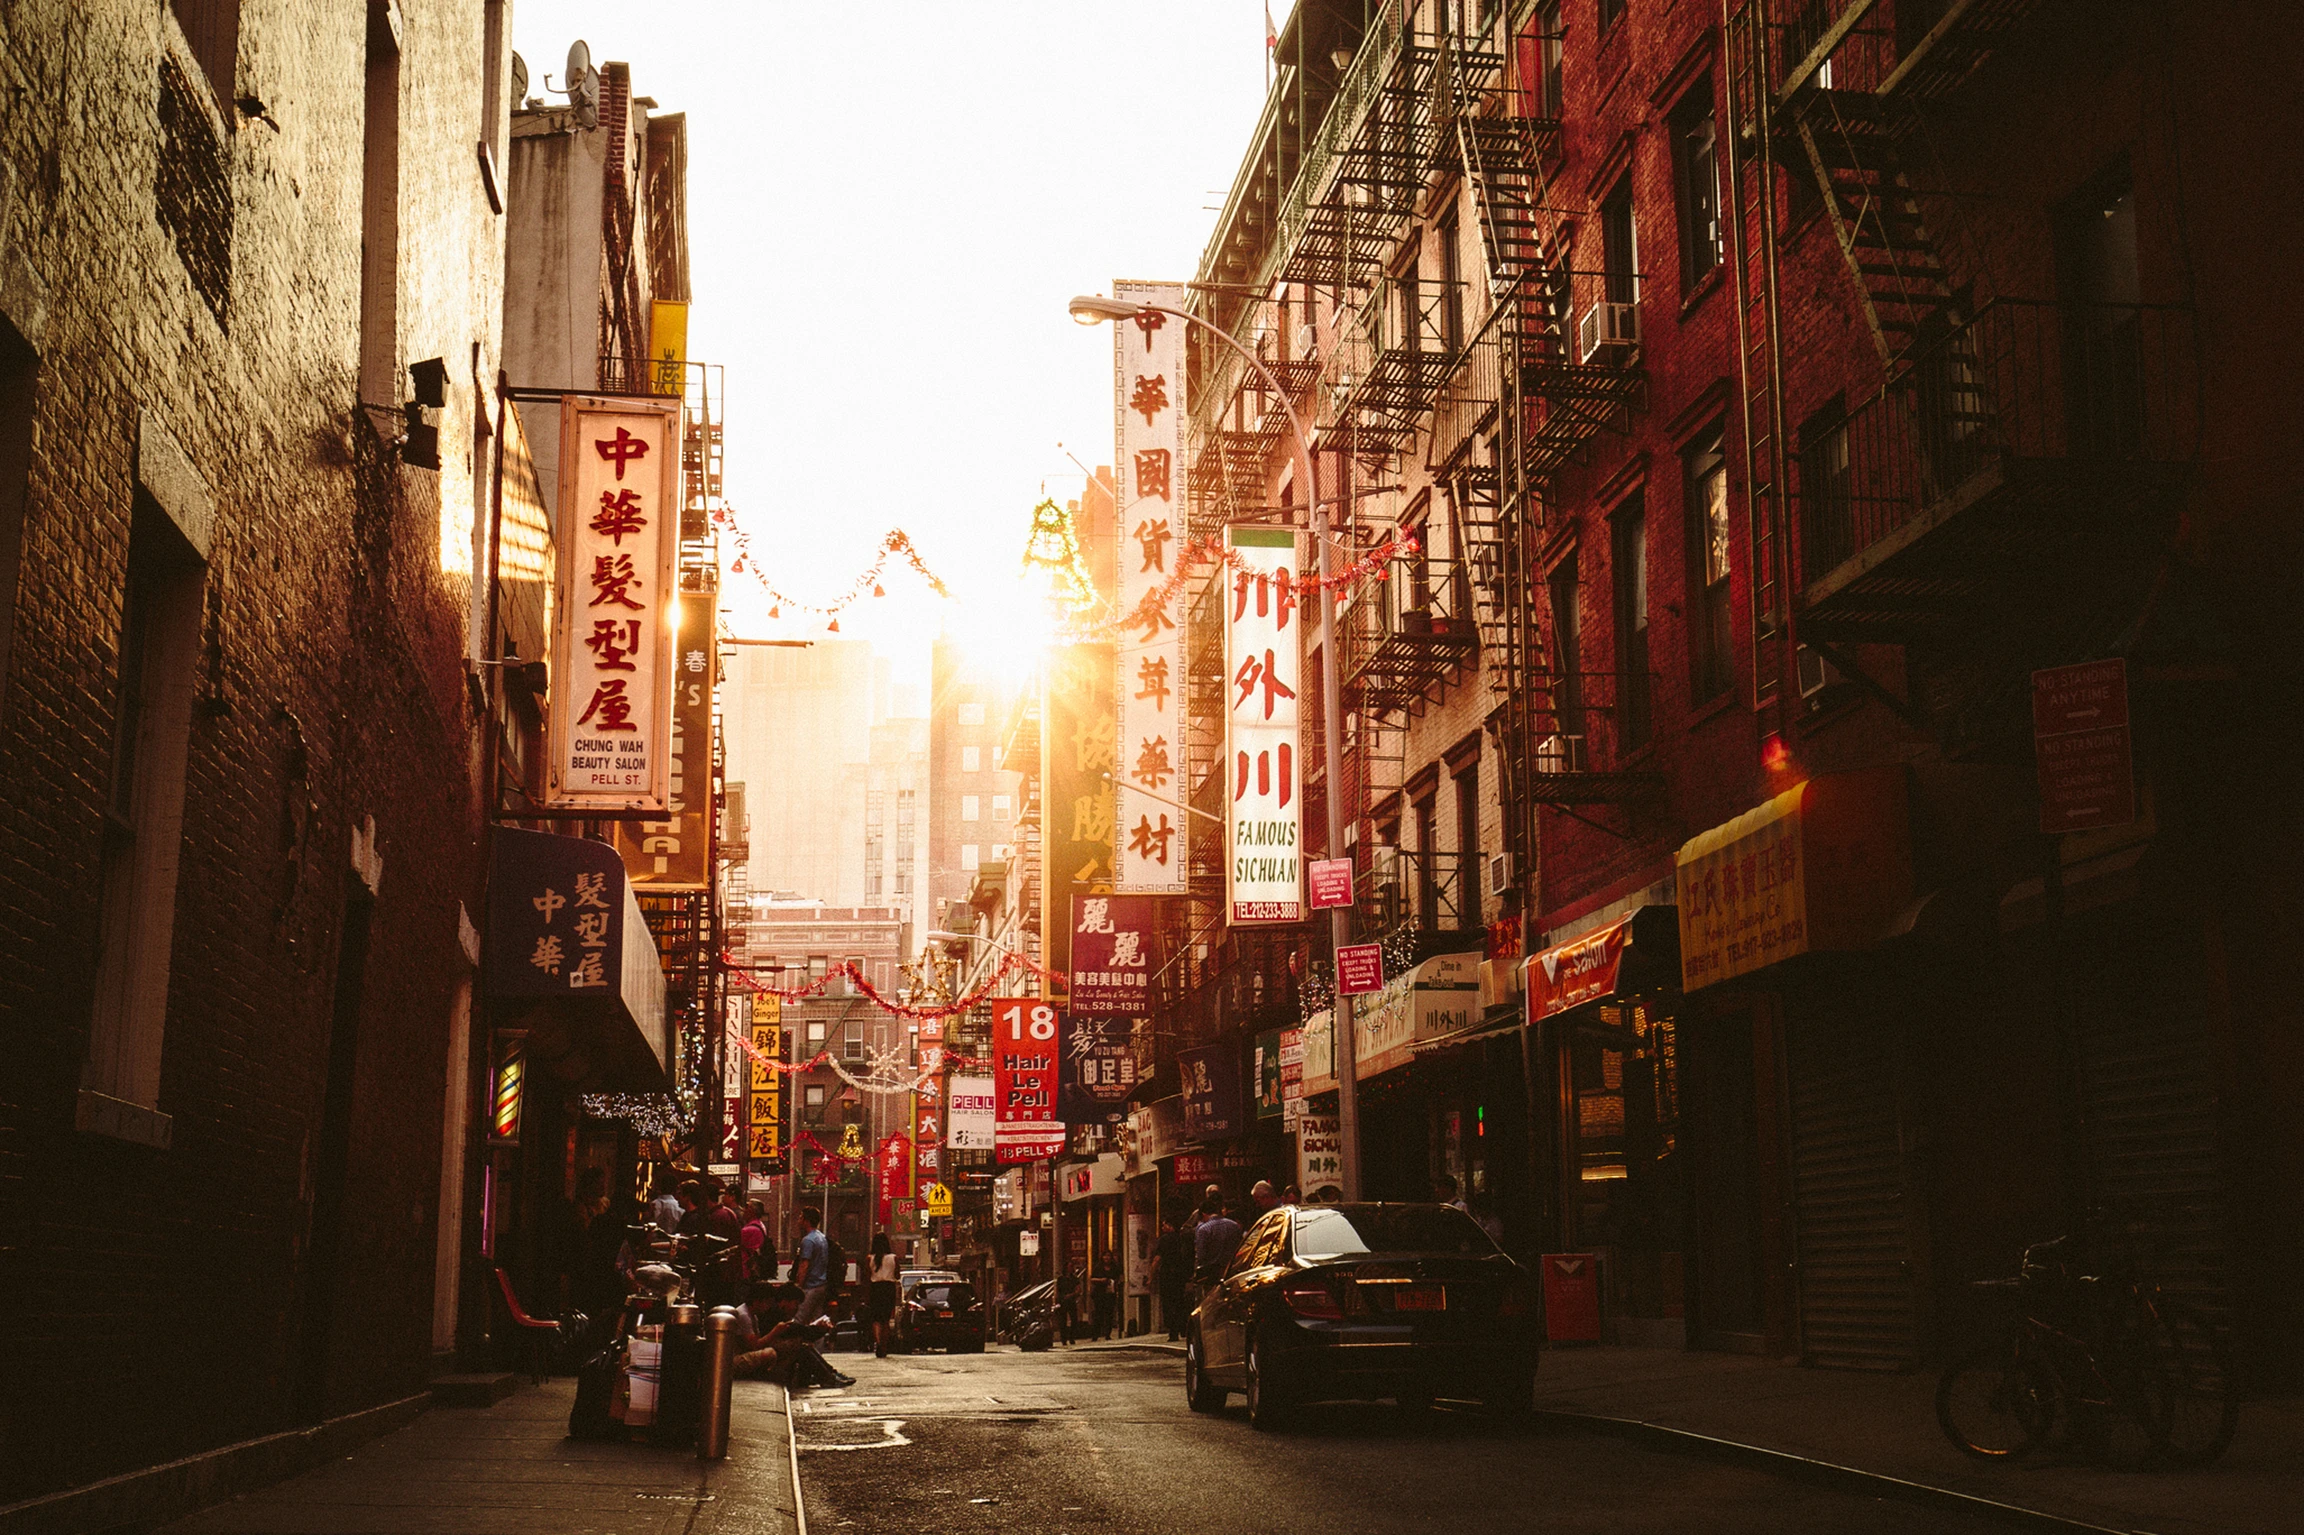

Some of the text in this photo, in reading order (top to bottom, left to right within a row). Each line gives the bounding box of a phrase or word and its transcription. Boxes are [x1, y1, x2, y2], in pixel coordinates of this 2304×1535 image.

[576, 426, 650, 733] 中華髮型屋
[2061, 666, 2119, 687] STANDING
[1233, 566, 1297, 809] 川外川
[2050, 686, 2110, 705] ANYTIME
[575, 739, 644, 752] CHUNG WAH
[2063, 733, 2122, 752] STANDING
[572, 757, 646, 769] BEAUTY SALON
[591, 774, 641, 785] PELL ST.
[1236, 820, 1297, 846] FAMOUS
[1235, 857, 1297, 883] SICHUAN
[529, 887, 566, 977] 中華
[573, 872, 612, 987] 髮型屋
[1350, 948, 1378, 957] STANDING
[753, 1008, 779, 1020] Ginger
[1002, 1005, 1055, 1040] 18
[1425, 1009, 1467, 1031] 川外川
[724, 997, 740, 1086] SHANGHAI
[1003, 1054, 1051, 1071] Hair
[1012, 1073, 1041, 1090] Le
[752, 1028, 778, 1156] 錦江飯店
[1007, 1090, 1050, 1107] Pell
[952, 1095, 994, 1109] PELL
[1302, 1119, 1340, 1136] FAMO
[1015, 1146, 1044, 1157] PELL
[1045, 1144, 1061, 1154] ST
[1304, 1138, 1341, 1154] SICHU
[931, 1206, 950, 1215] AHEAD
